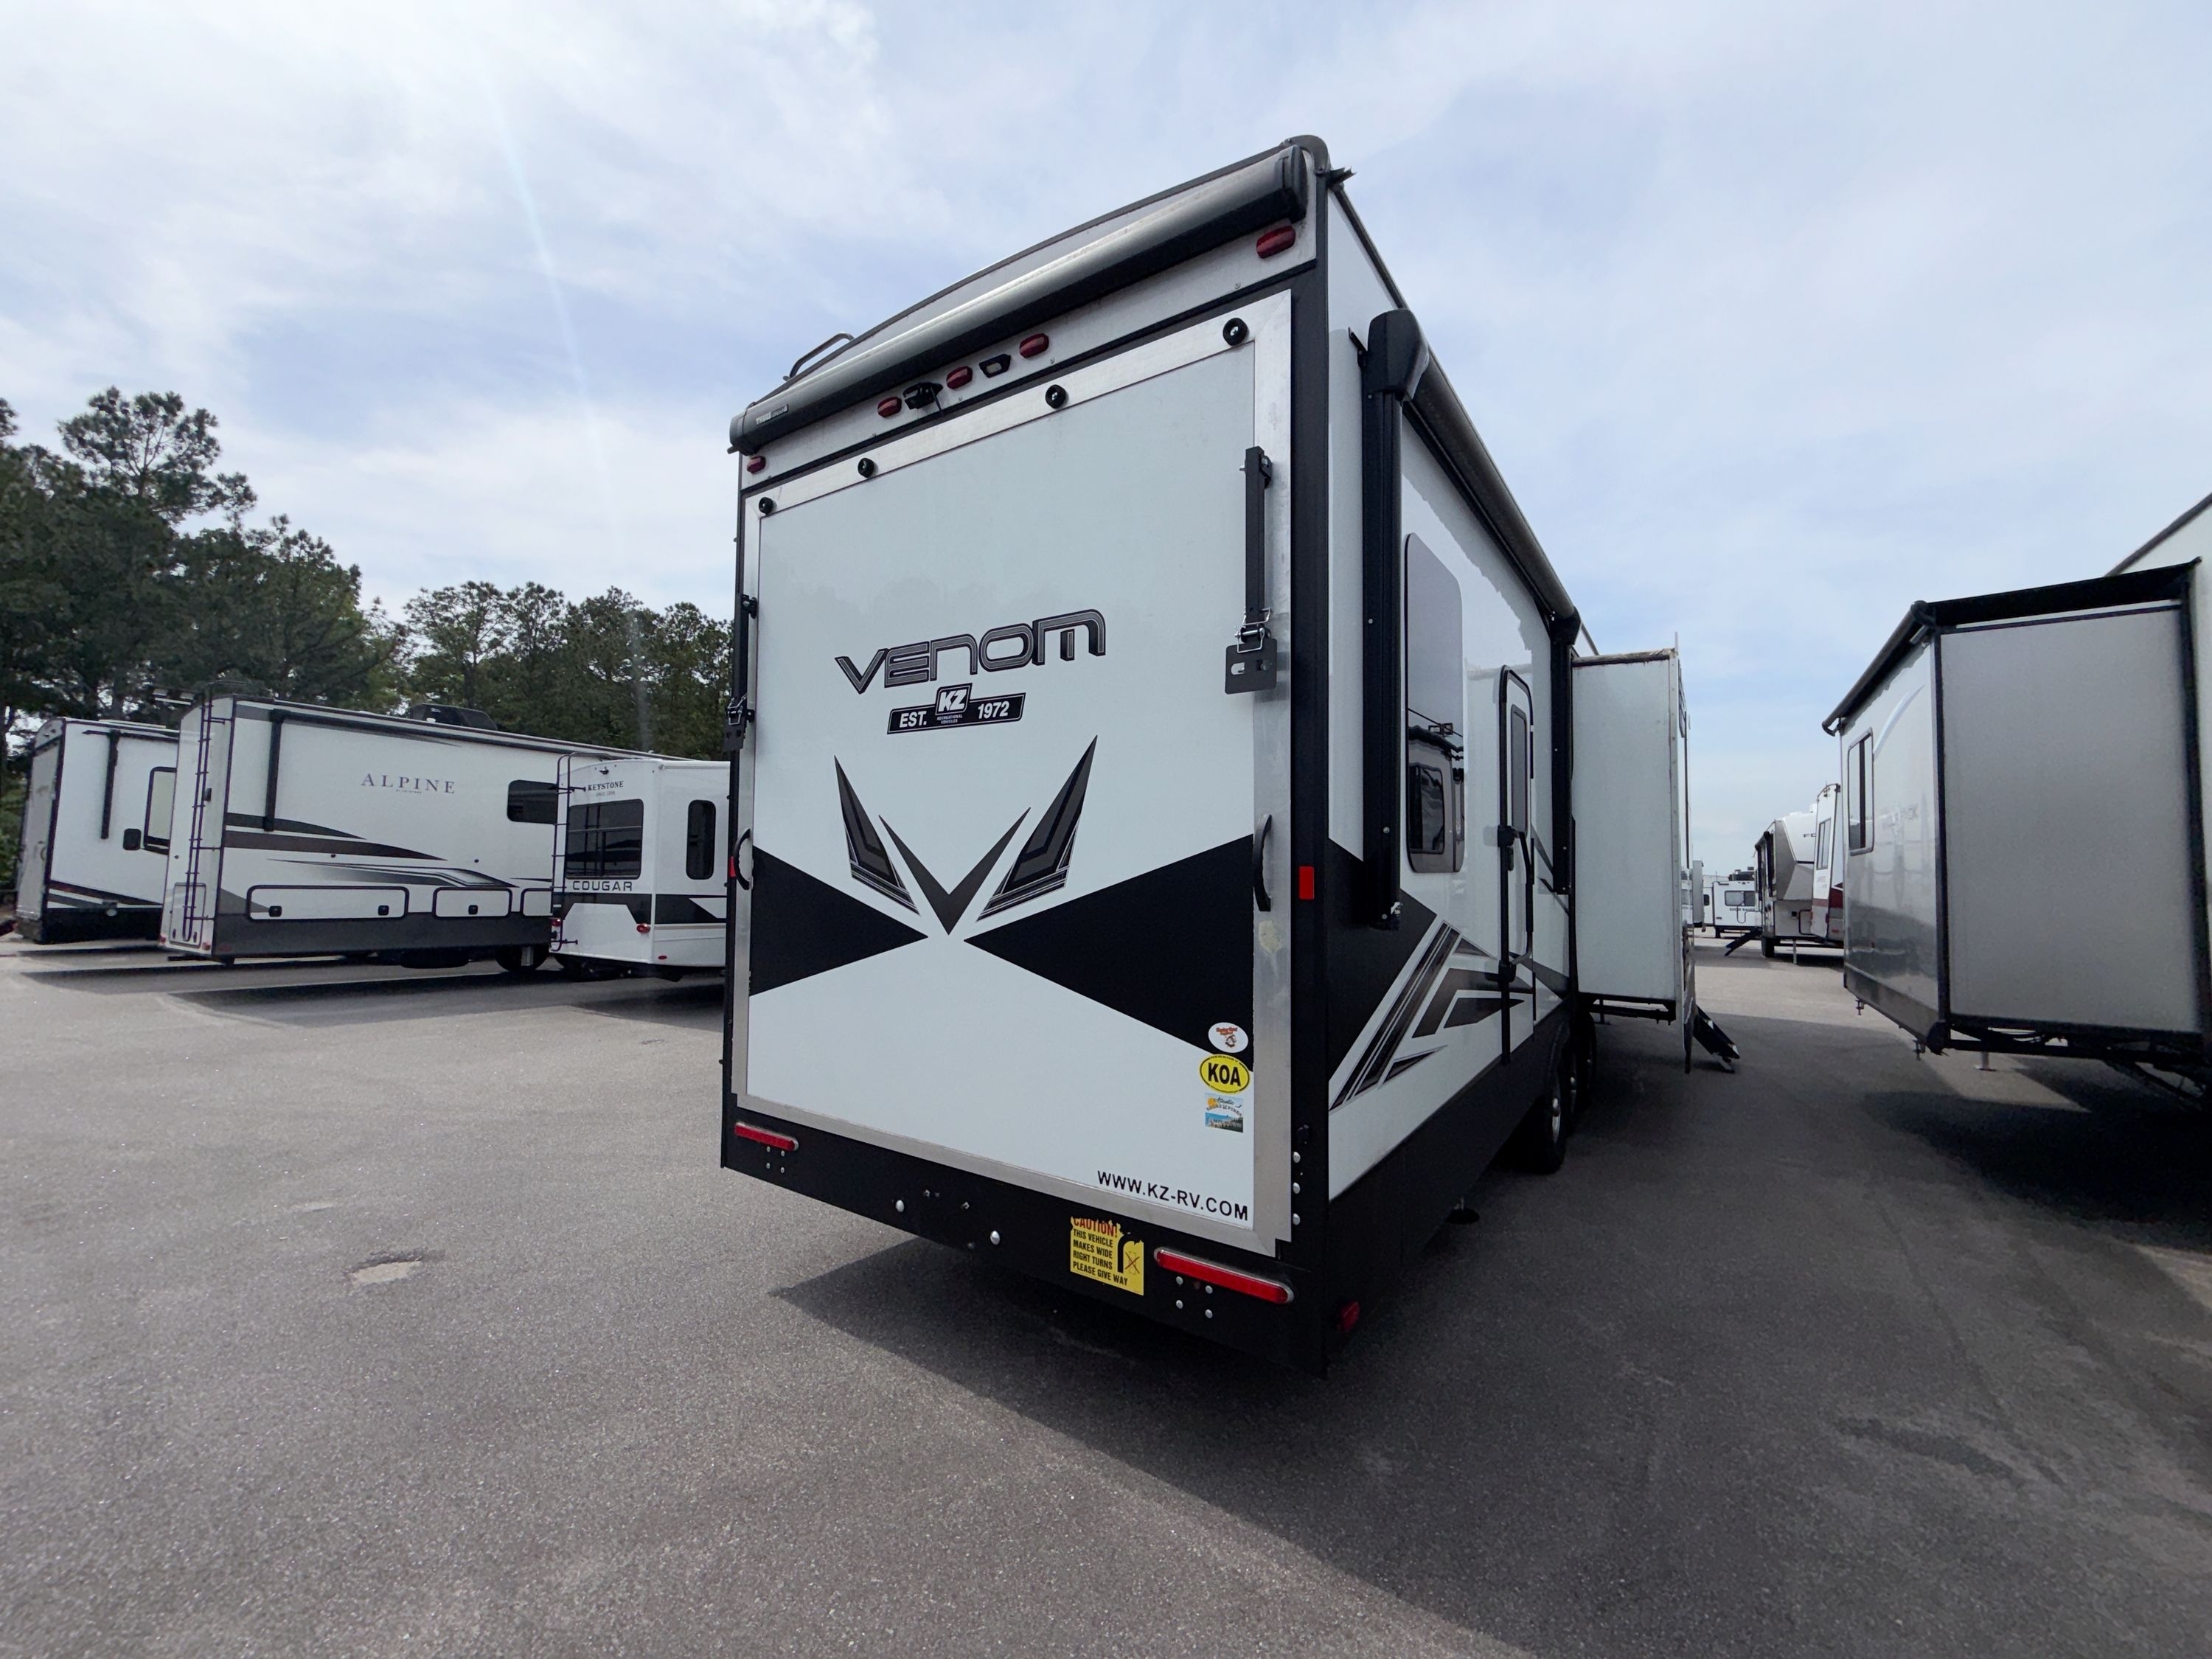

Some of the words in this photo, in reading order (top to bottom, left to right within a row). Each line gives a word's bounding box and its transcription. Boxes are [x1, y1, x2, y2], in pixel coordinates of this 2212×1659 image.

[834, 609, 1106, 695] VENOM
[938, 689, 967, 712] KZ
[899, 711, 928, 728] EST.
[978, 701, 1009, 719] 1972
[360, 773, 455, 793] ALPINE
[588, 781, 624, 791] KEYSTONE
[573, 880, 633, 891] COUGAR
[1208, 1062, 1241, 1087] KOA
[1098, 1170, 1248, 1221] WWW.KZ-RV.COM
[1074, 1228, 1087, 1239] THIS
[1088, 1232, 1113, 1248] VEHICLE
[1073, 1239, 1095, 1253] MAKES
[1096, 1246, 1113, 1259] WIDE
[1073, 1250, 1091, 1263] RIGHT
[1092, 1256, 1113, 1270] TURNS
[1073, 1261, 1096, 1276] PLEASE
[1097, 1269, 1112, 1281] GIVE
[1113, 1273, 1128, 1286] WAY
